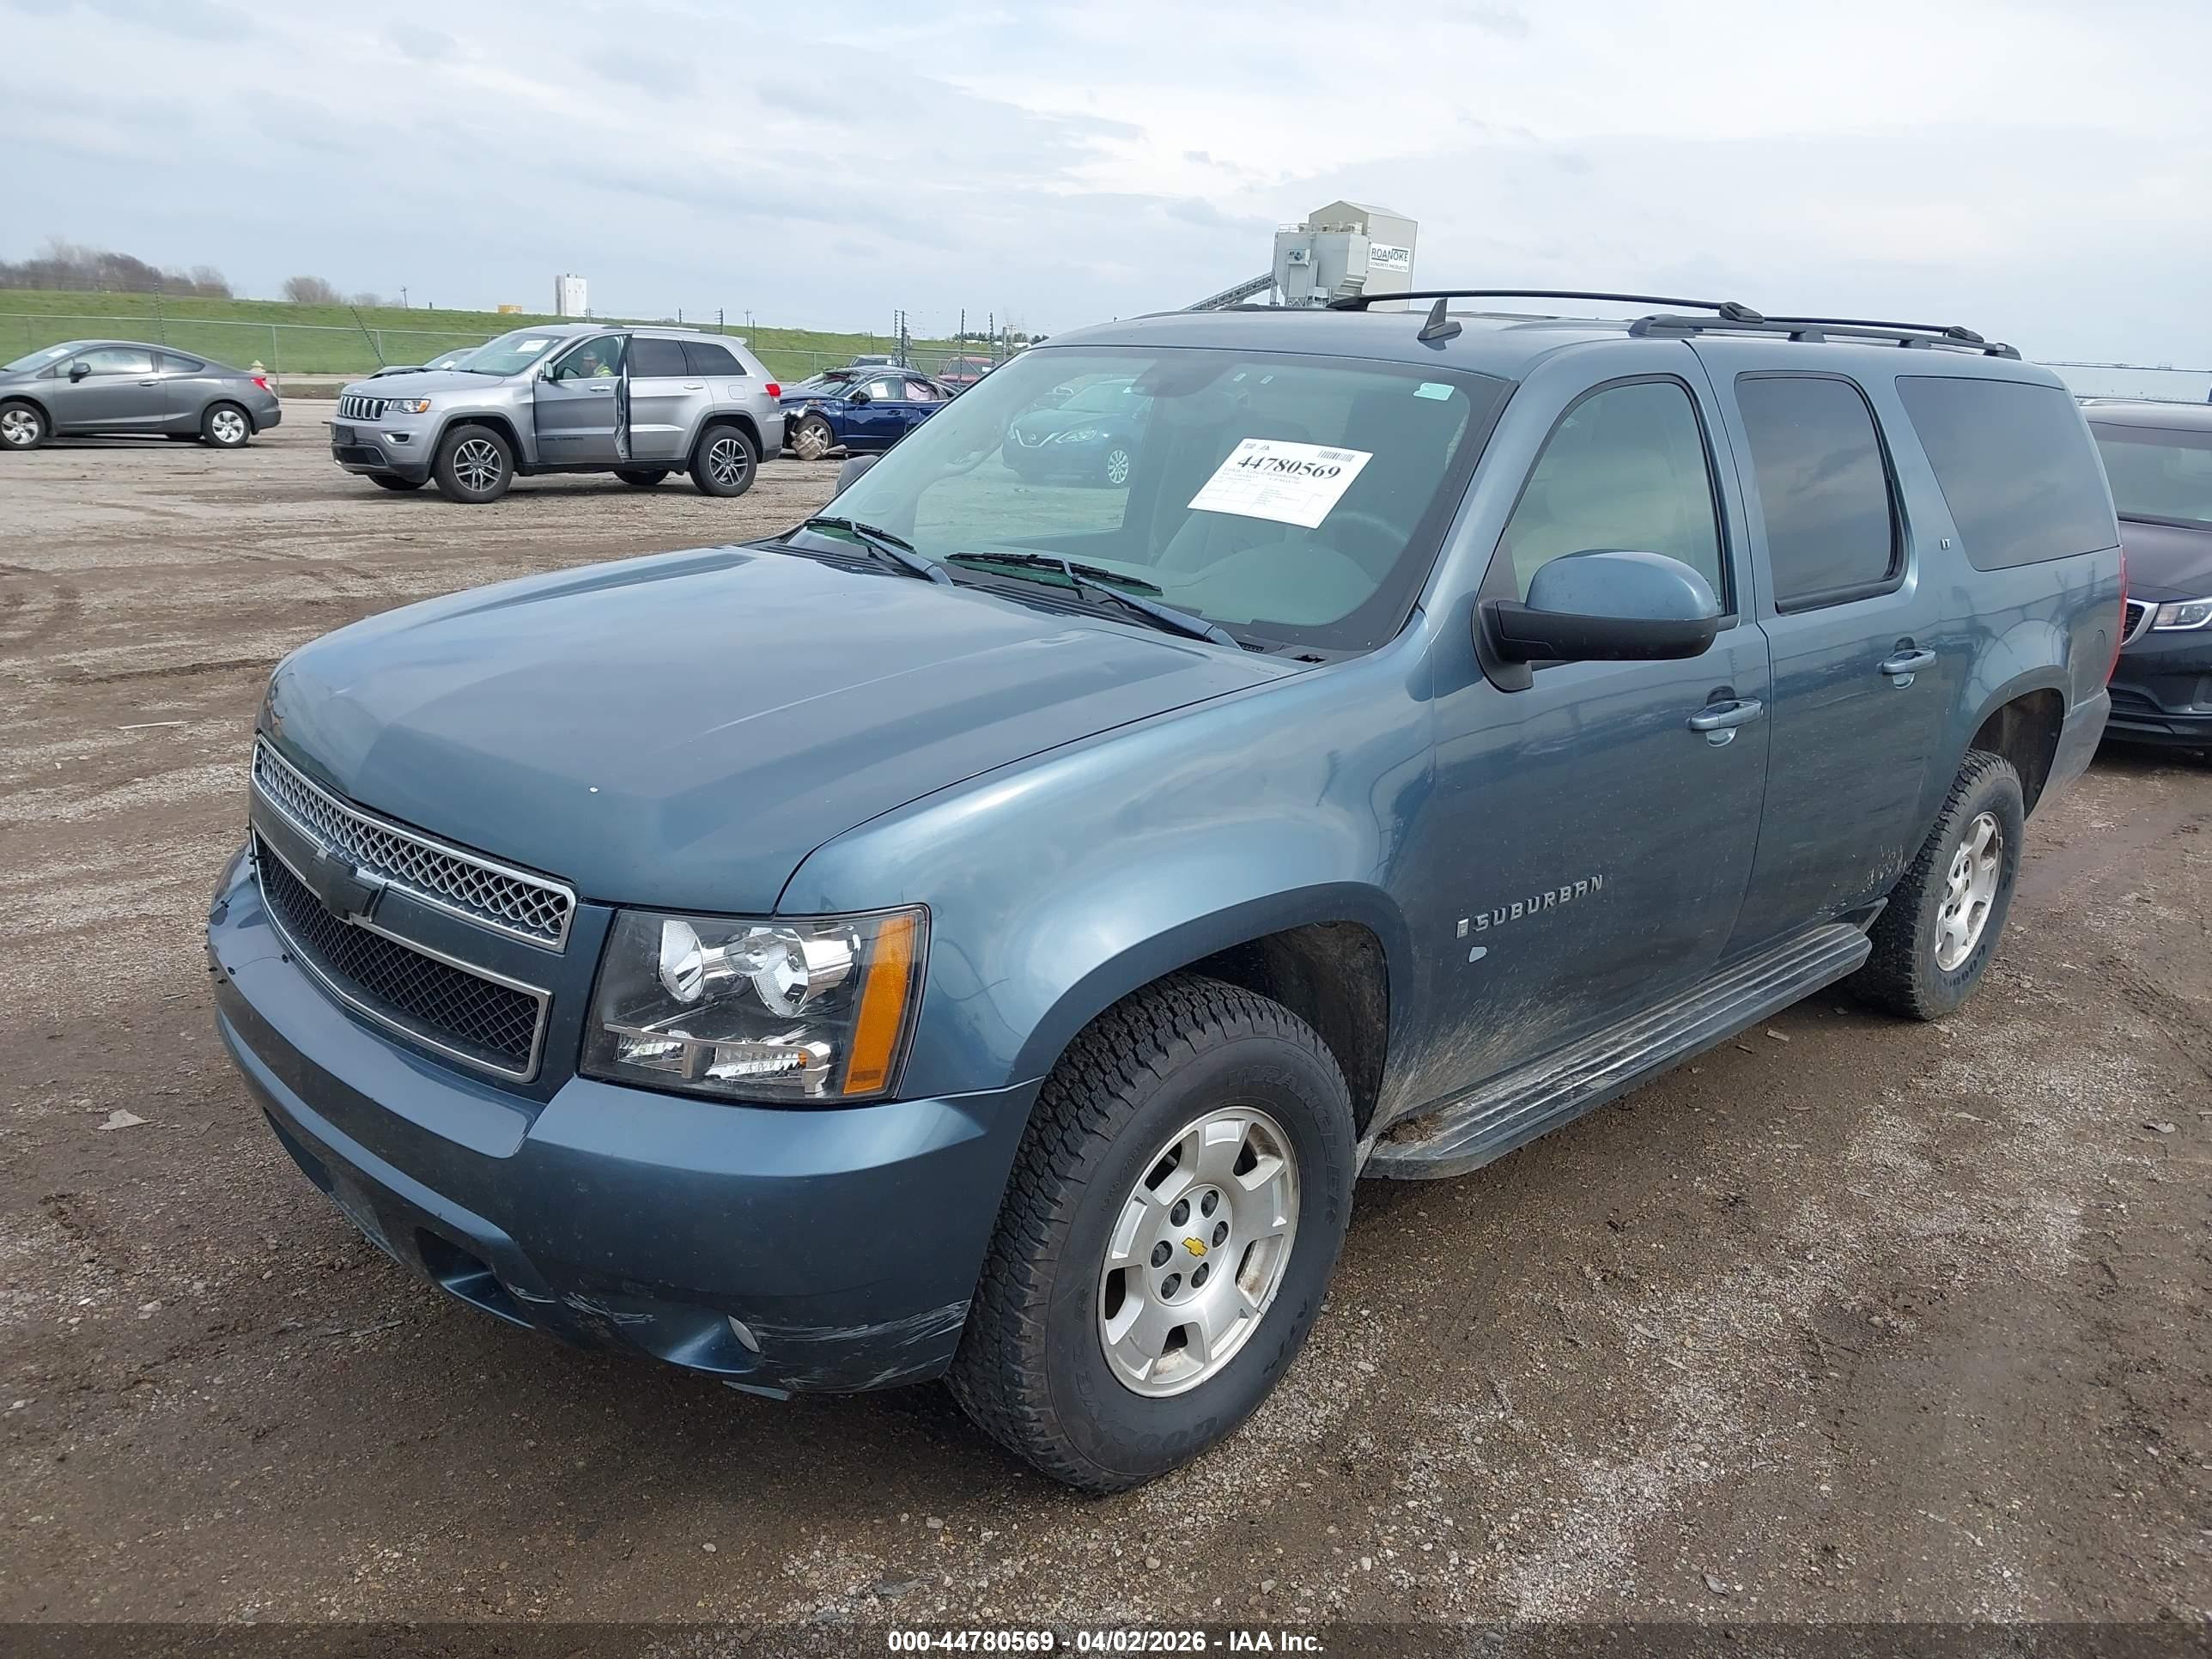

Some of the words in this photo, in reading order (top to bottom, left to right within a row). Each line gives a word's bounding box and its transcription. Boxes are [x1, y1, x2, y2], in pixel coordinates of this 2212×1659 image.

[1371, 247, 1408, 262] ROANOKE
[1237, 455, 1341, 479] 44780569
[1473, 874, 1603, 933] SUBURBAN
[1225, 1064, 1340, 1225] WRANGLER
